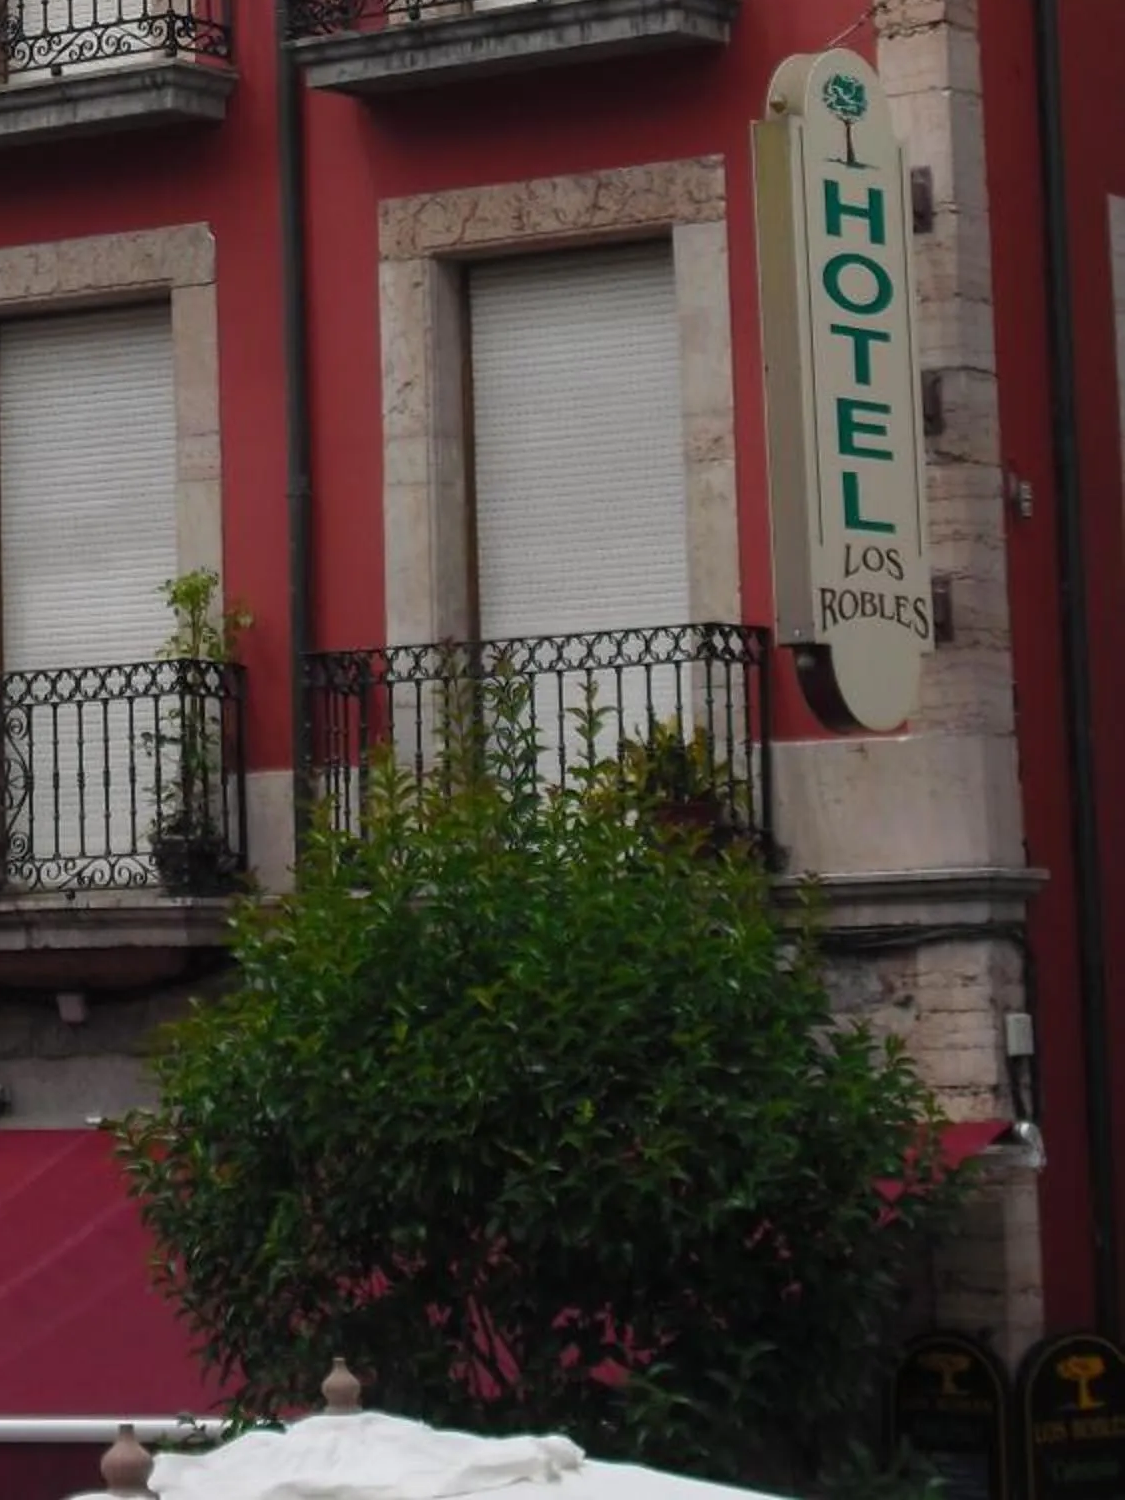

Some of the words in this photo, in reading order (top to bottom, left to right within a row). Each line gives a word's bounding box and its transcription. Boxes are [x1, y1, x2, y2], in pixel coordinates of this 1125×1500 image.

[822, 178, 896, 534] HOTEL
[844, 543, 904, 581] LOS
[819, 587, 930, 640] ROBLES
